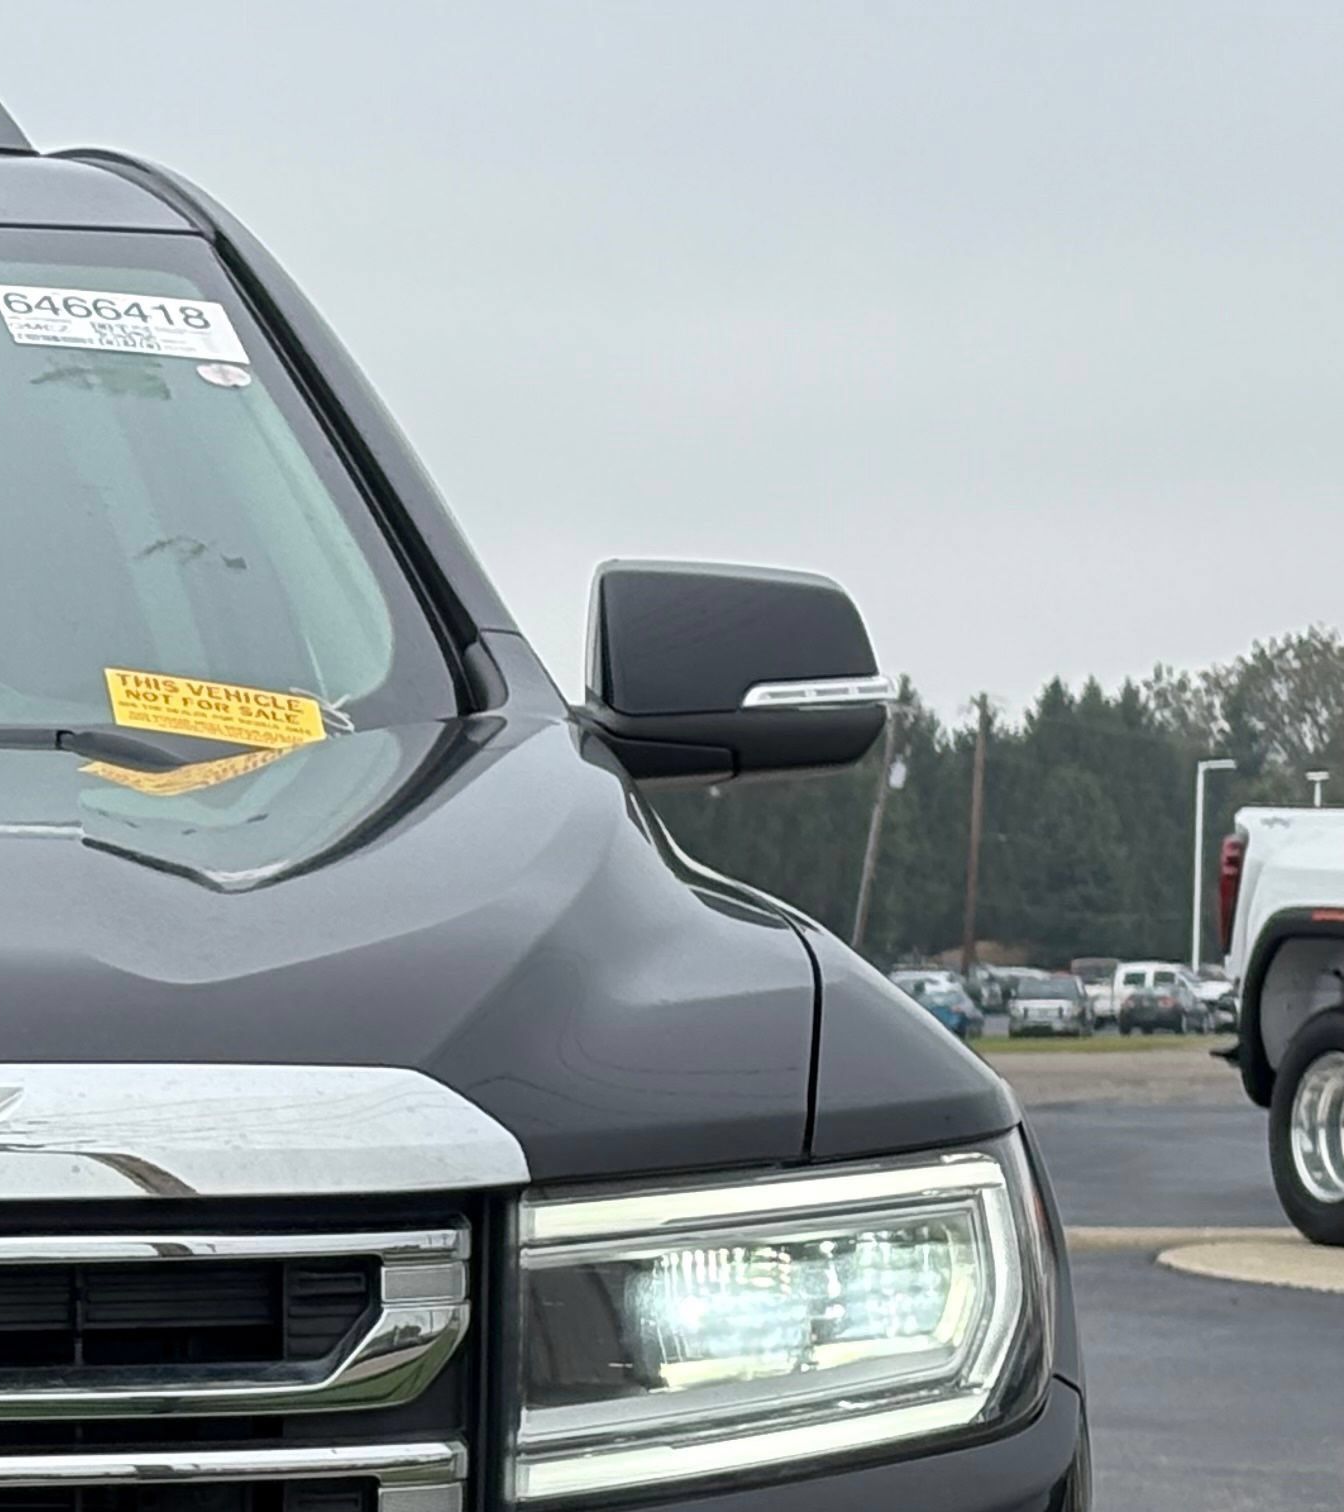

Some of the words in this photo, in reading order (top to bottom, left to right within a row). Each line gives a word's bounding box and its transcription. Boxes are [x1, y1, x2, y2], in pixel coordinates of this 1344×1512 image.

[3, 292, 211, 330] 6466418
[115, 673, 179, 693] THIS
[185, 682, 305, 714] VEHICLE
[125, 689, 172, 704] NOT
[181, 697, 230, 713] FOR
[238, 706, 301, 725] SALE
